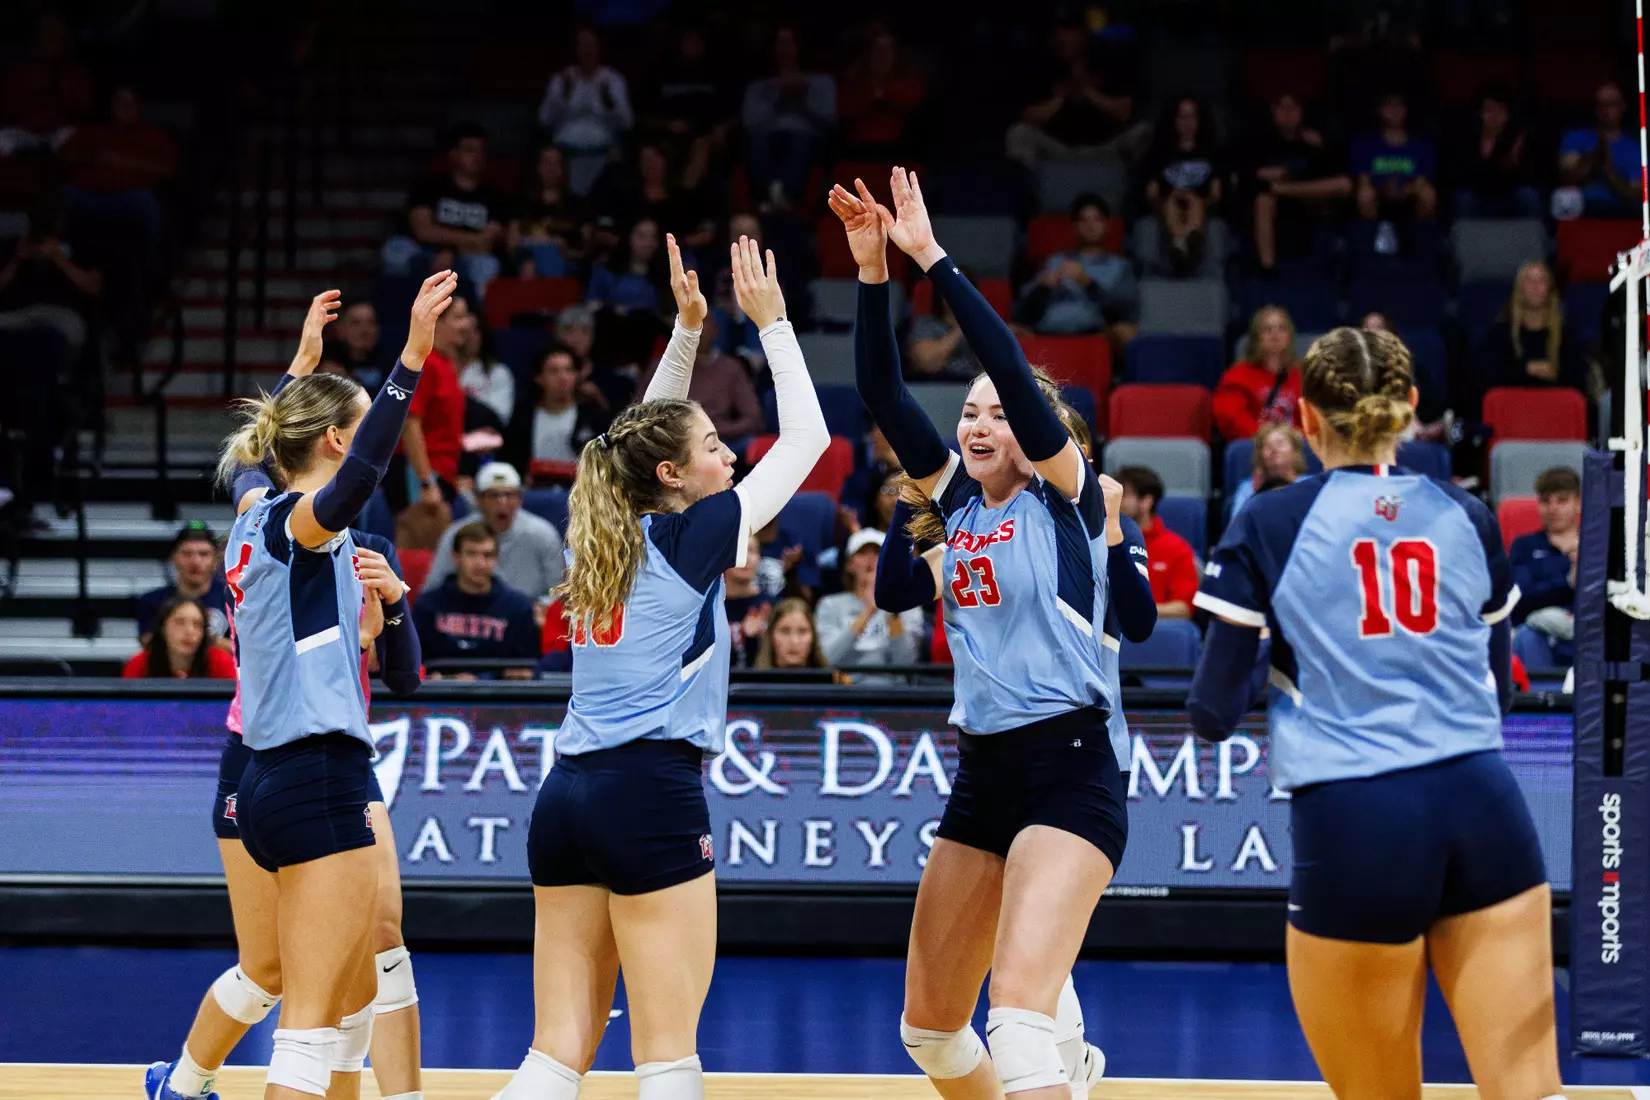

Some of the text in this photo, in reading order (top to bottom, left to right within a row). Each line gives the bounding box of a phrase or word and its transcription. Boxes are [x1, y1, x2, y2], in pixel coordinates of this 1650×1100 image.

[951, 554, 1002, 608] 23
[1351, 536, 1440, 638] 10
[709, 718, 788, 795] &
[1181, 825, 1279, 872] LA
[1598, 792, 1624, 869] sports
